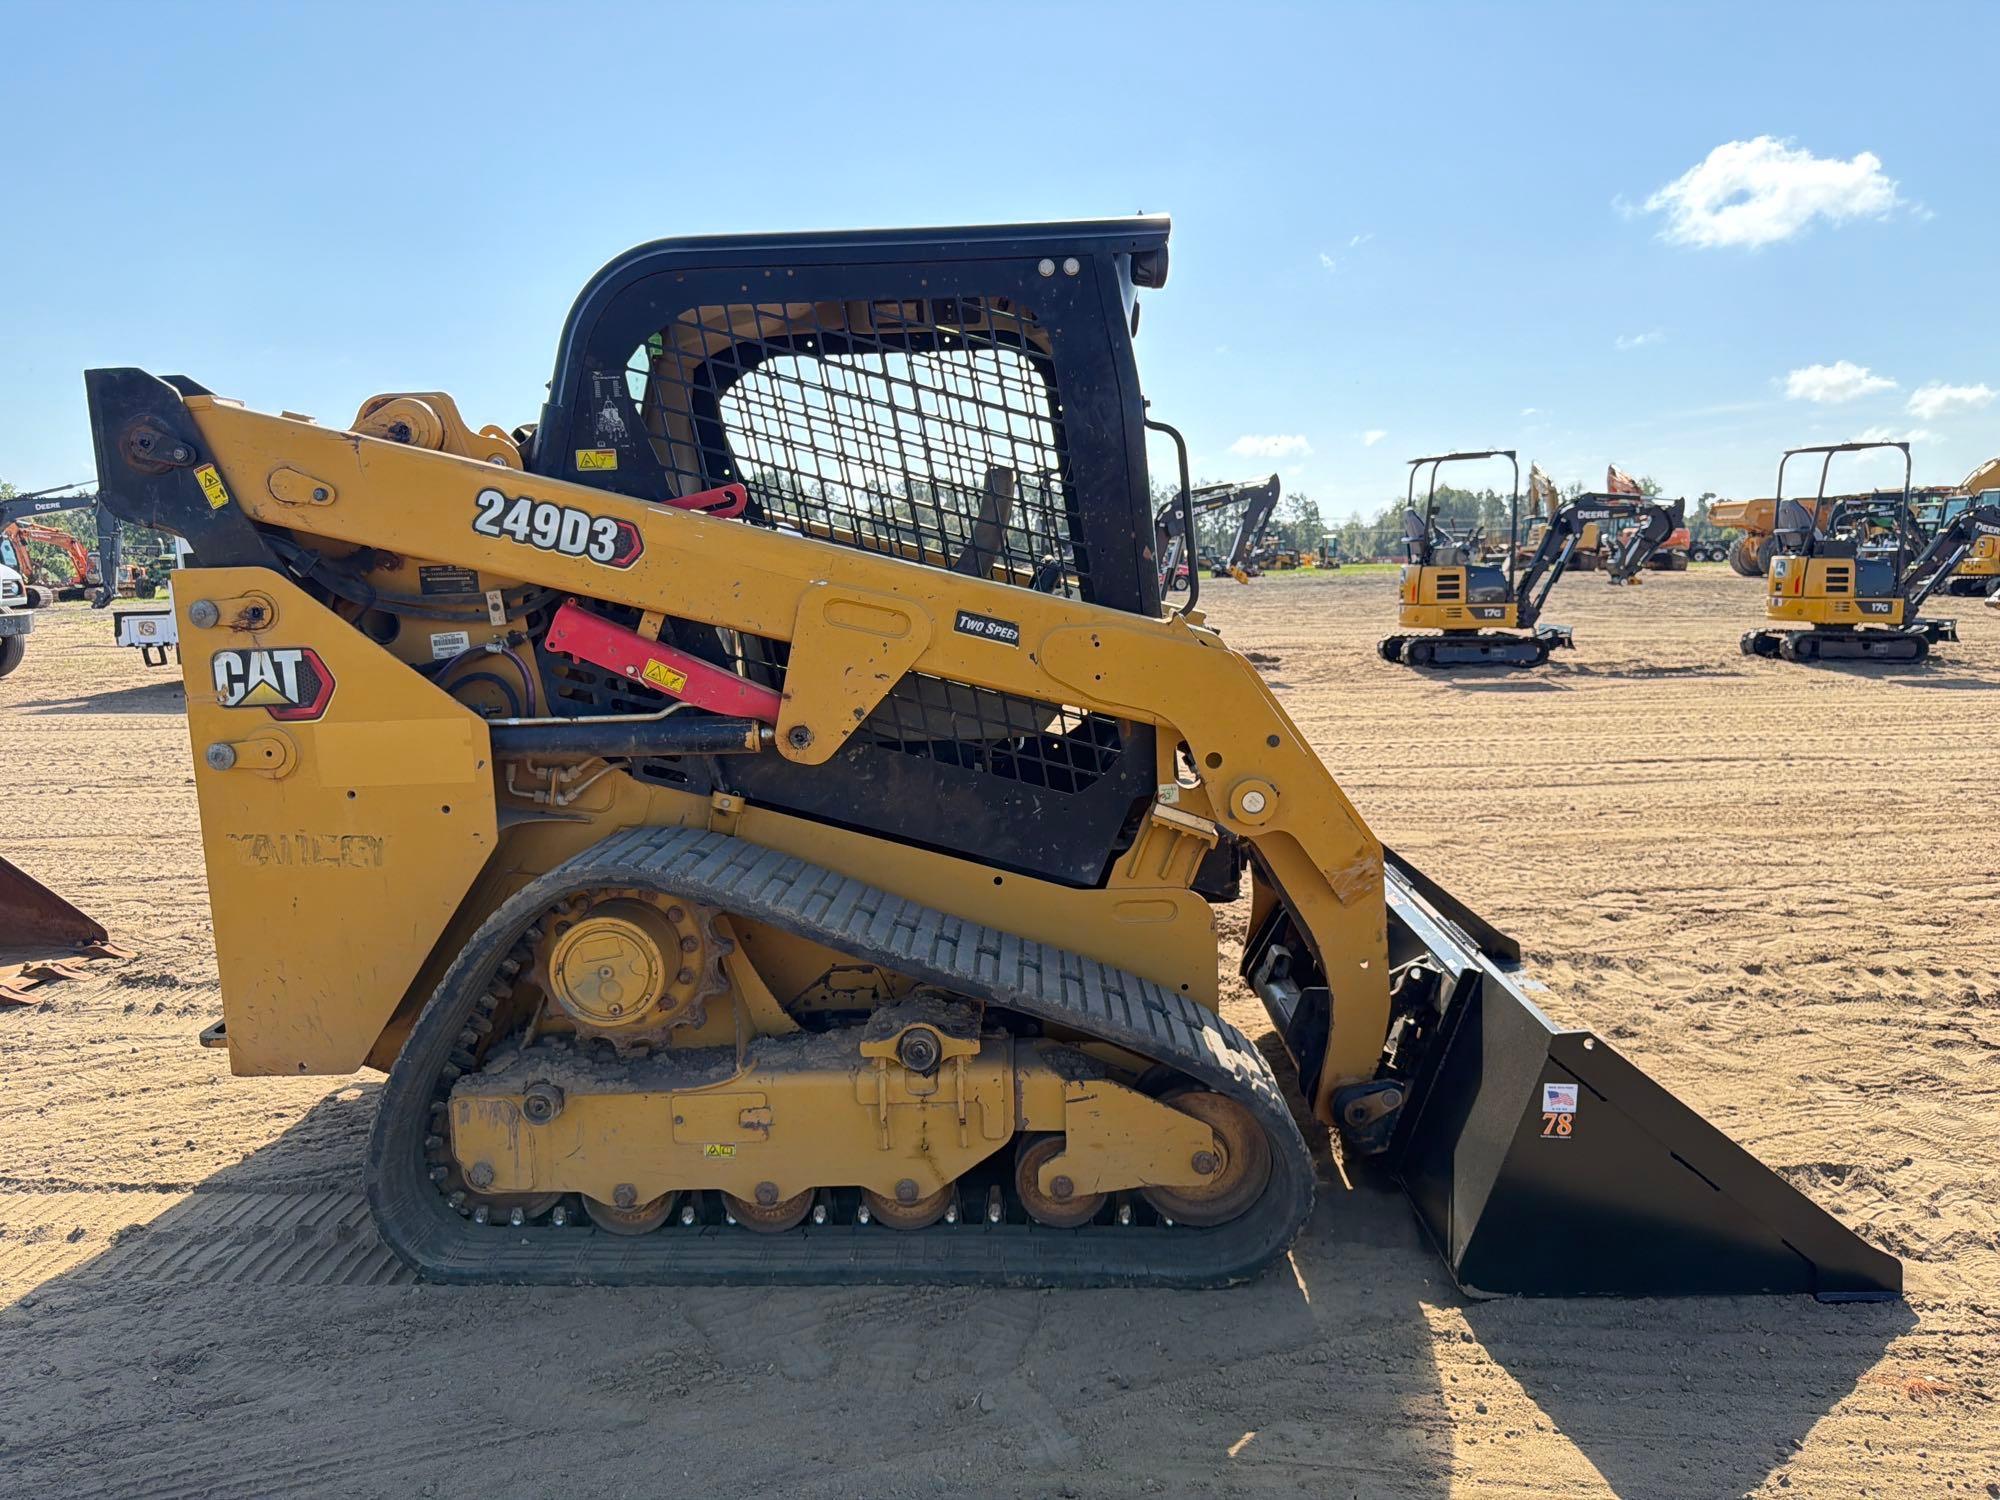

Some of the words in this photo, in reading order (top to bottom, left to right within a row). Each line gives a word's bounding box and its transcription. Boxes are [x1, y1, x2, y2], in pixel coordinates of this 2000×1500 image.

[35, 502, 61, 511] DEERE
[1175, 504, 1208, 520] DRE
[1577, 510, 1610, 519] DEERE
[474, 489, 618, 561] 249D3
[1974, 521, 2000, 535] DEER
[1484, 609, 1501, 618] 17G
[1871, 602, 1888, 612] 17G
[959, 616, 984, 632] TWO
[213, 650, 302, 706] CAT
[1542, 1112, 1573, 1136] 78
